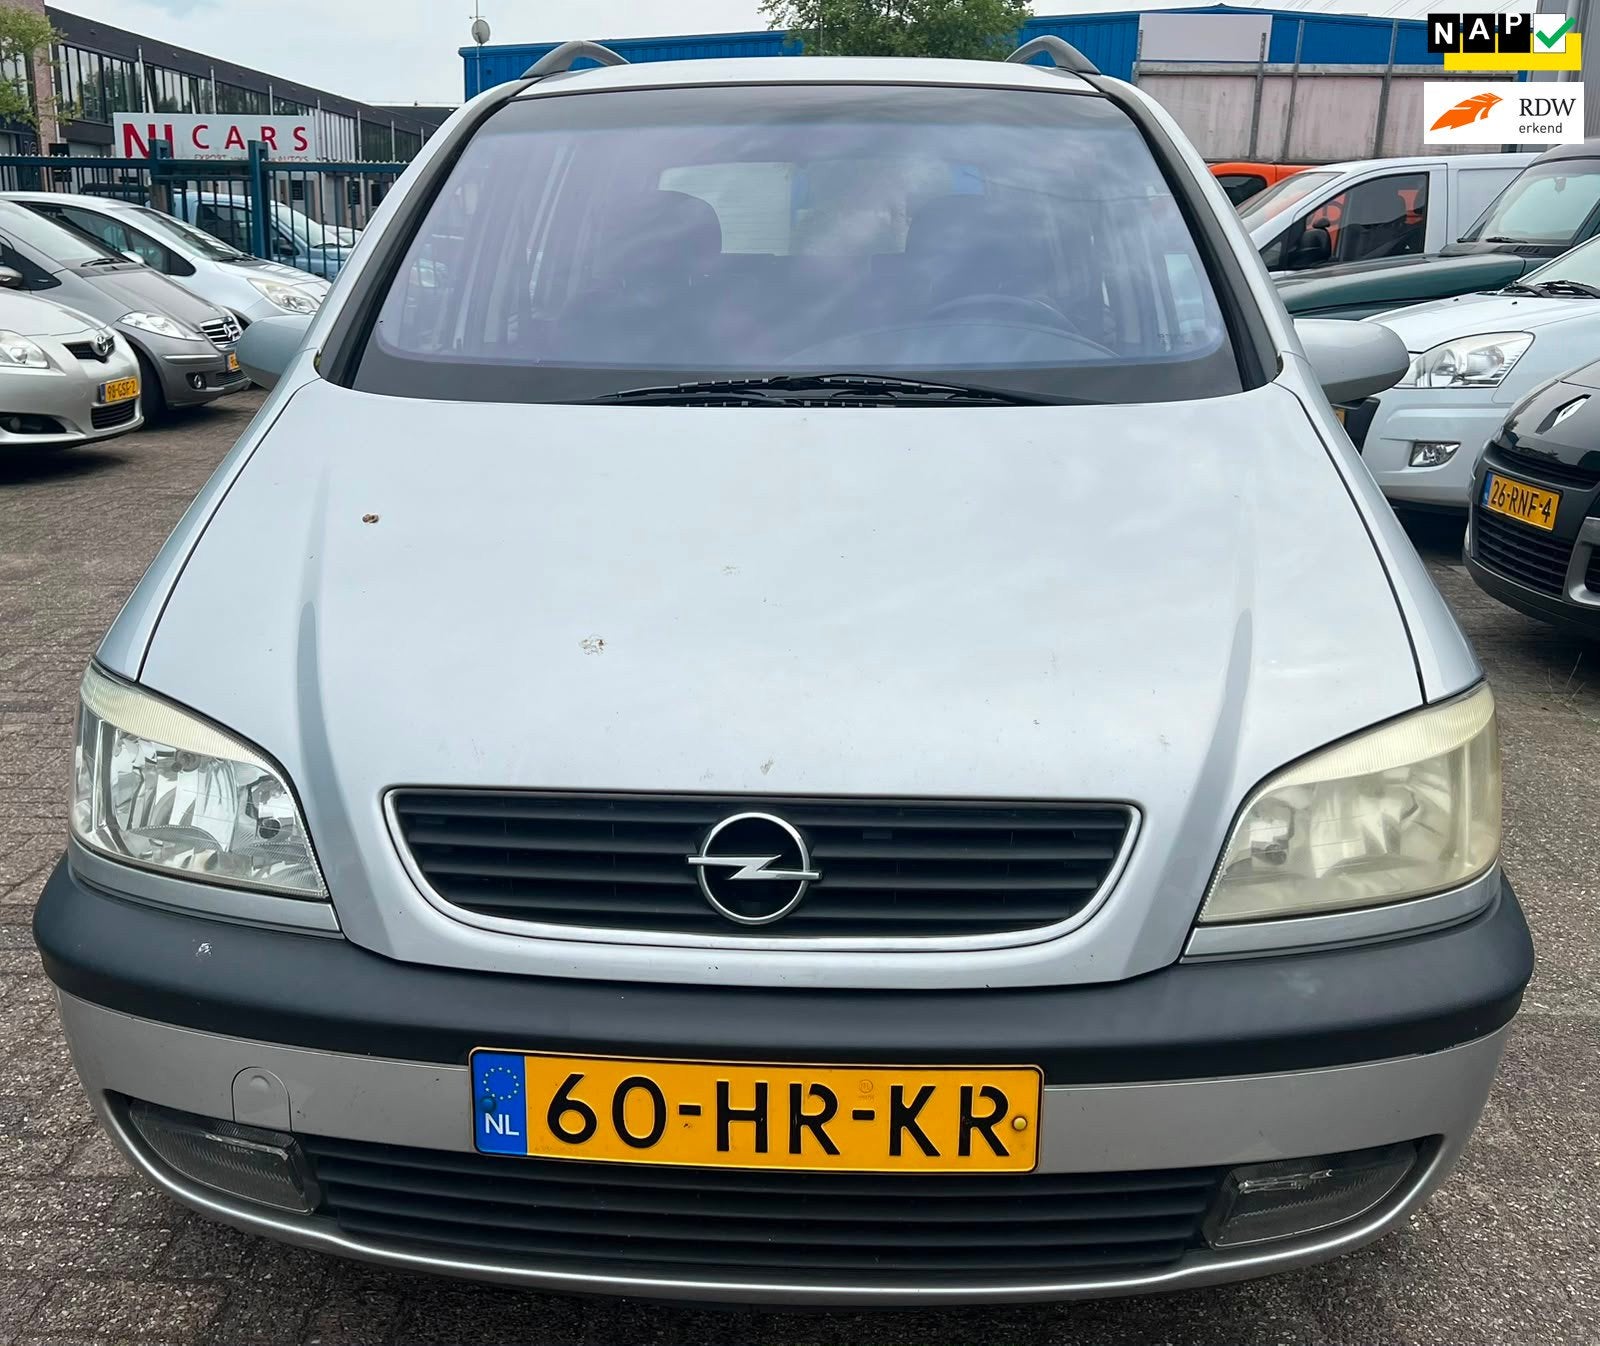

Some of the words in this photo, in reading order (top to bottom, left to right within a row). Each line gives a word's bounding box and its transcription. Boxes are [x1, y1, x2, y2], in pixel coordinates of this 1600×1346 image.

[191, 125, 308, 151] CARS
[1491, 480, 1552, 523] 26-RNF-4
[485, 1112, 520, 1136] NL
[546, 1073, 1011, 1157] 60-HR-KR
